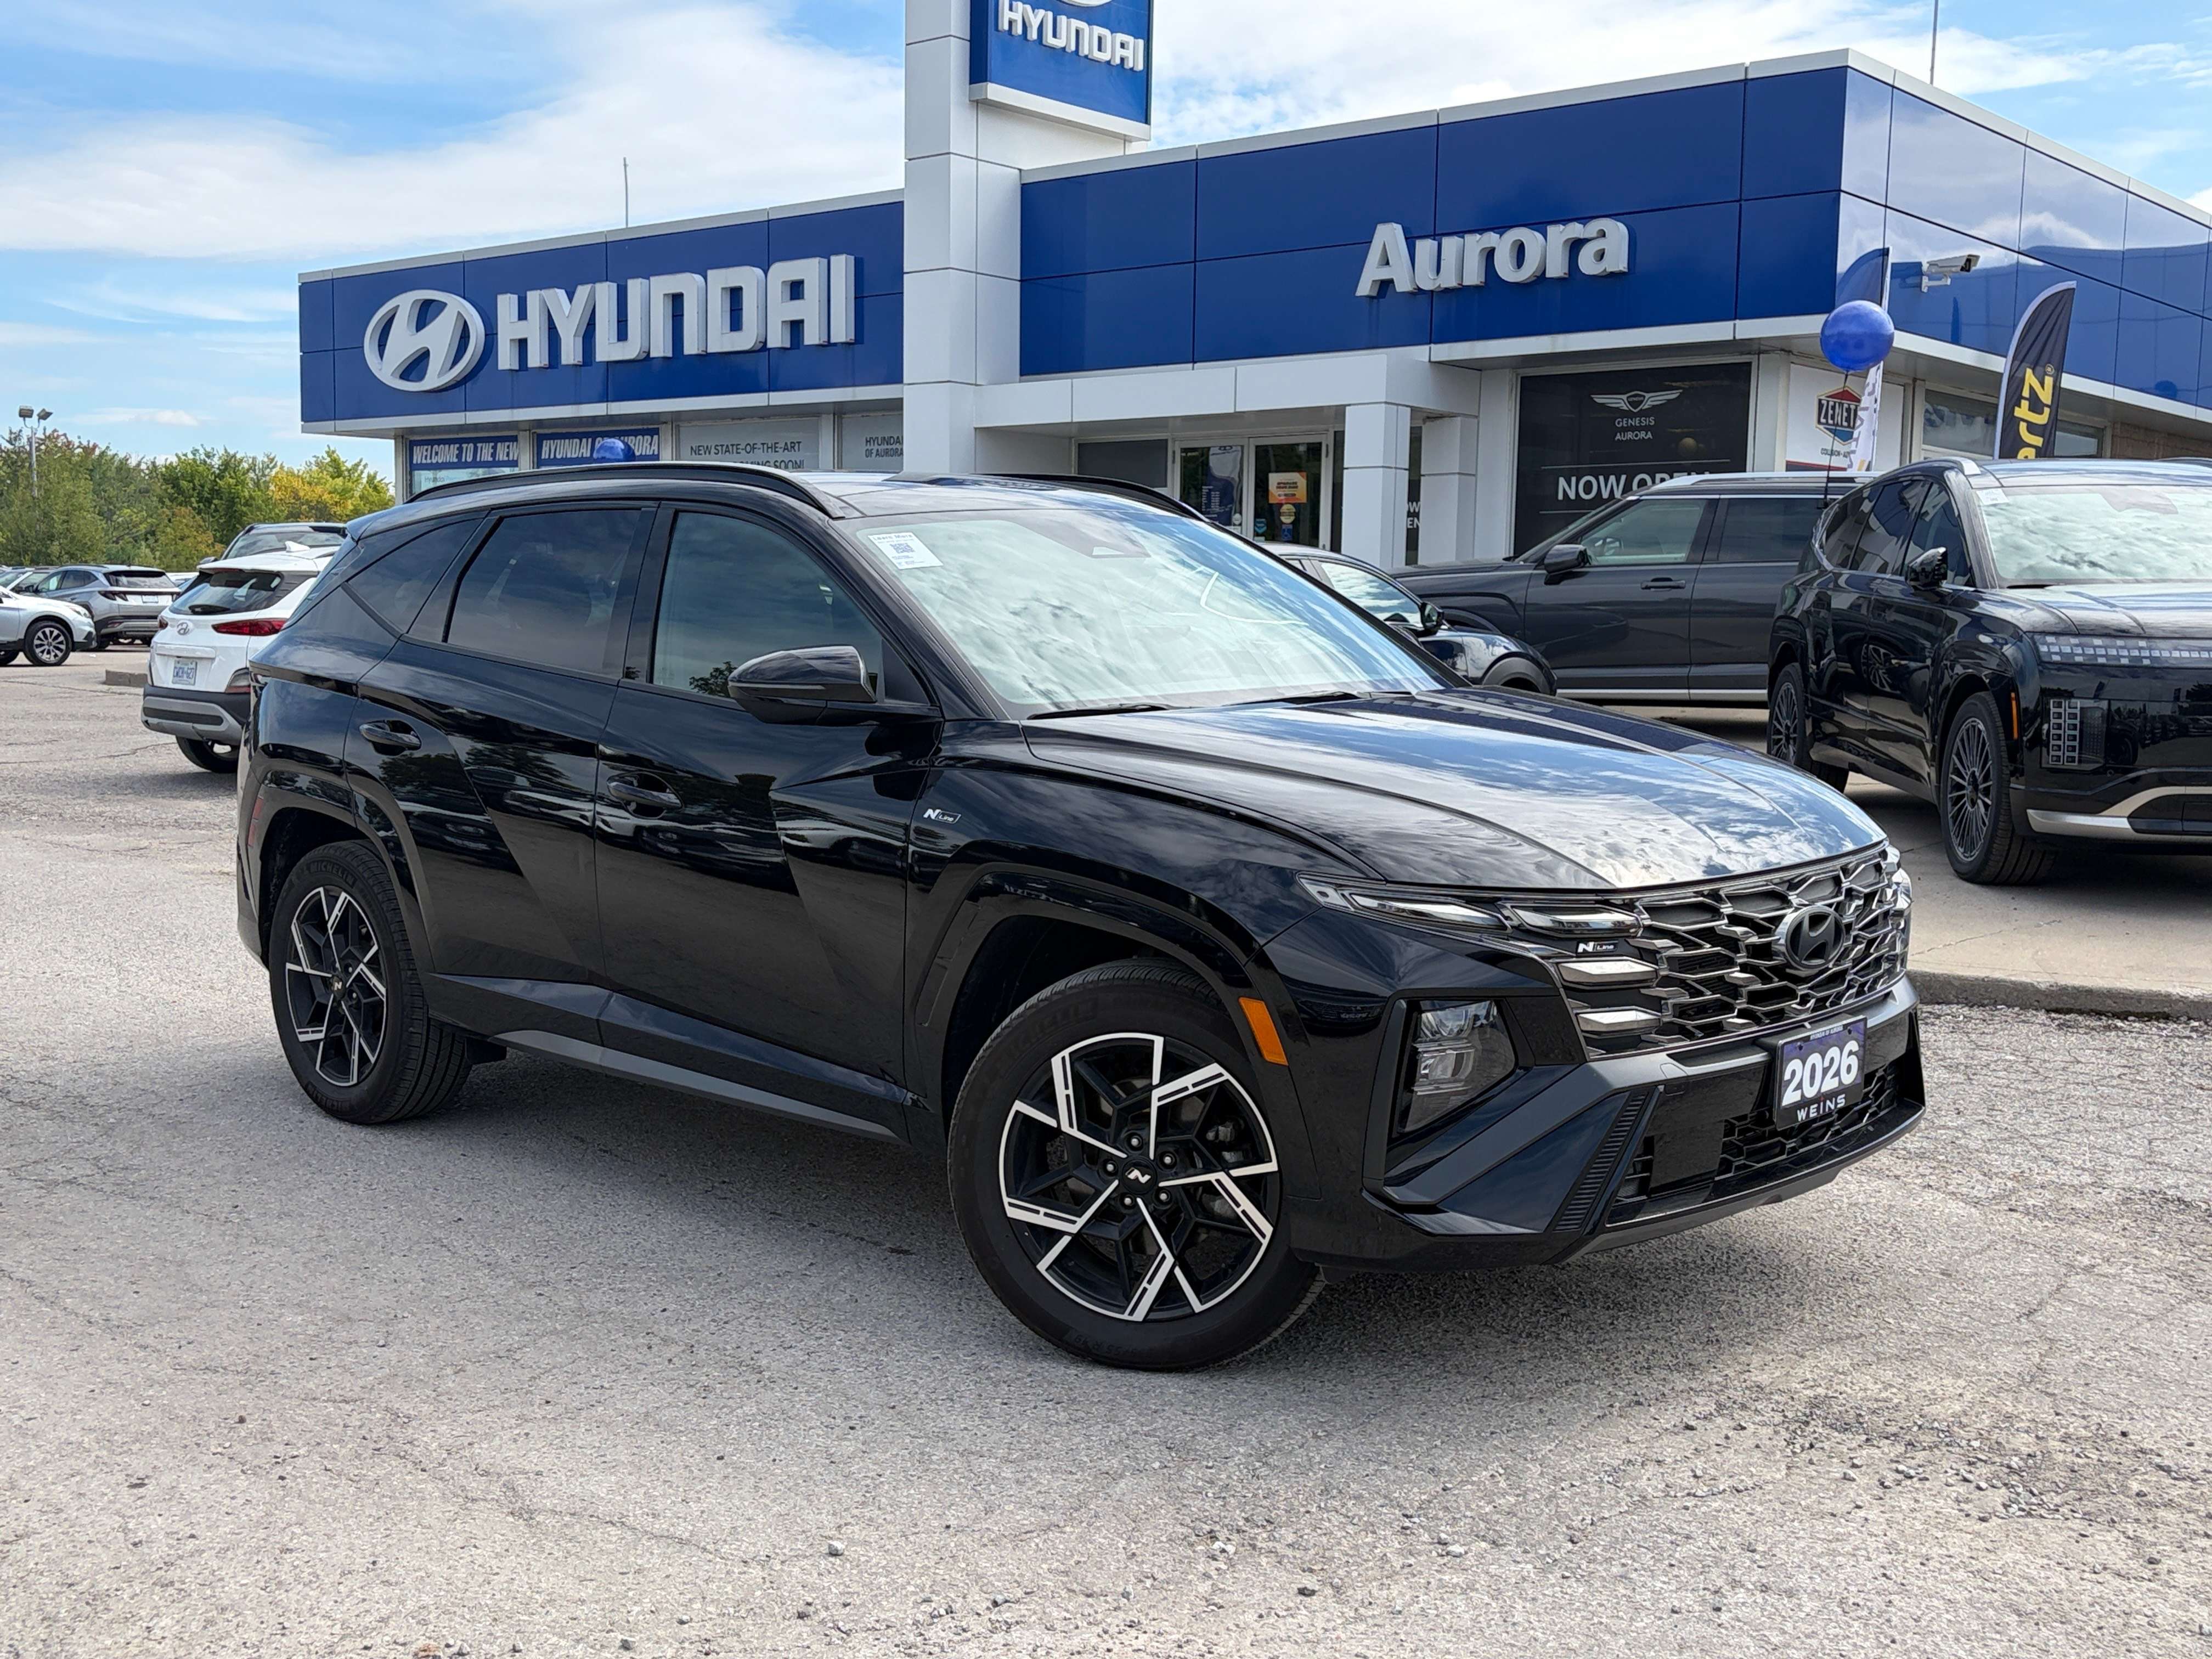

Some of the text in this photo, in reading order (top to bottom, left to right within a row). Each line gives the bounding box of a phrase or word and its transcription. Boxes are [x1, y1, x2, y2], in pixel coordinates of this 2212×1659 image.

[998, 0, 1144, 71] HYUNDAI
[1355, 217, 1629, 298] Aurora
[497, 254, 855, 370] HYUNDAI
[1615, 417, 1655, 427] GENESIS
[1820, 400, 1856, 428] ZENET
[541, 438, 592, 459] HYUNDAI
[690, 441, 802, 456] NEW STATE-OF-THE-ART
[1615, 431, 1652, 441] AURORA
[413, 441, 519, 464] WELCOME TO THE NEW
[865, 447, 904, 458] OF AURORA
[1558, 474, 1627, 501] NOW
[311, 861, 354, 885] MICHELIN
[1782, 1040, 1859, 1107] 2026
[1797, 1094, 1846, 1122] WEINS
